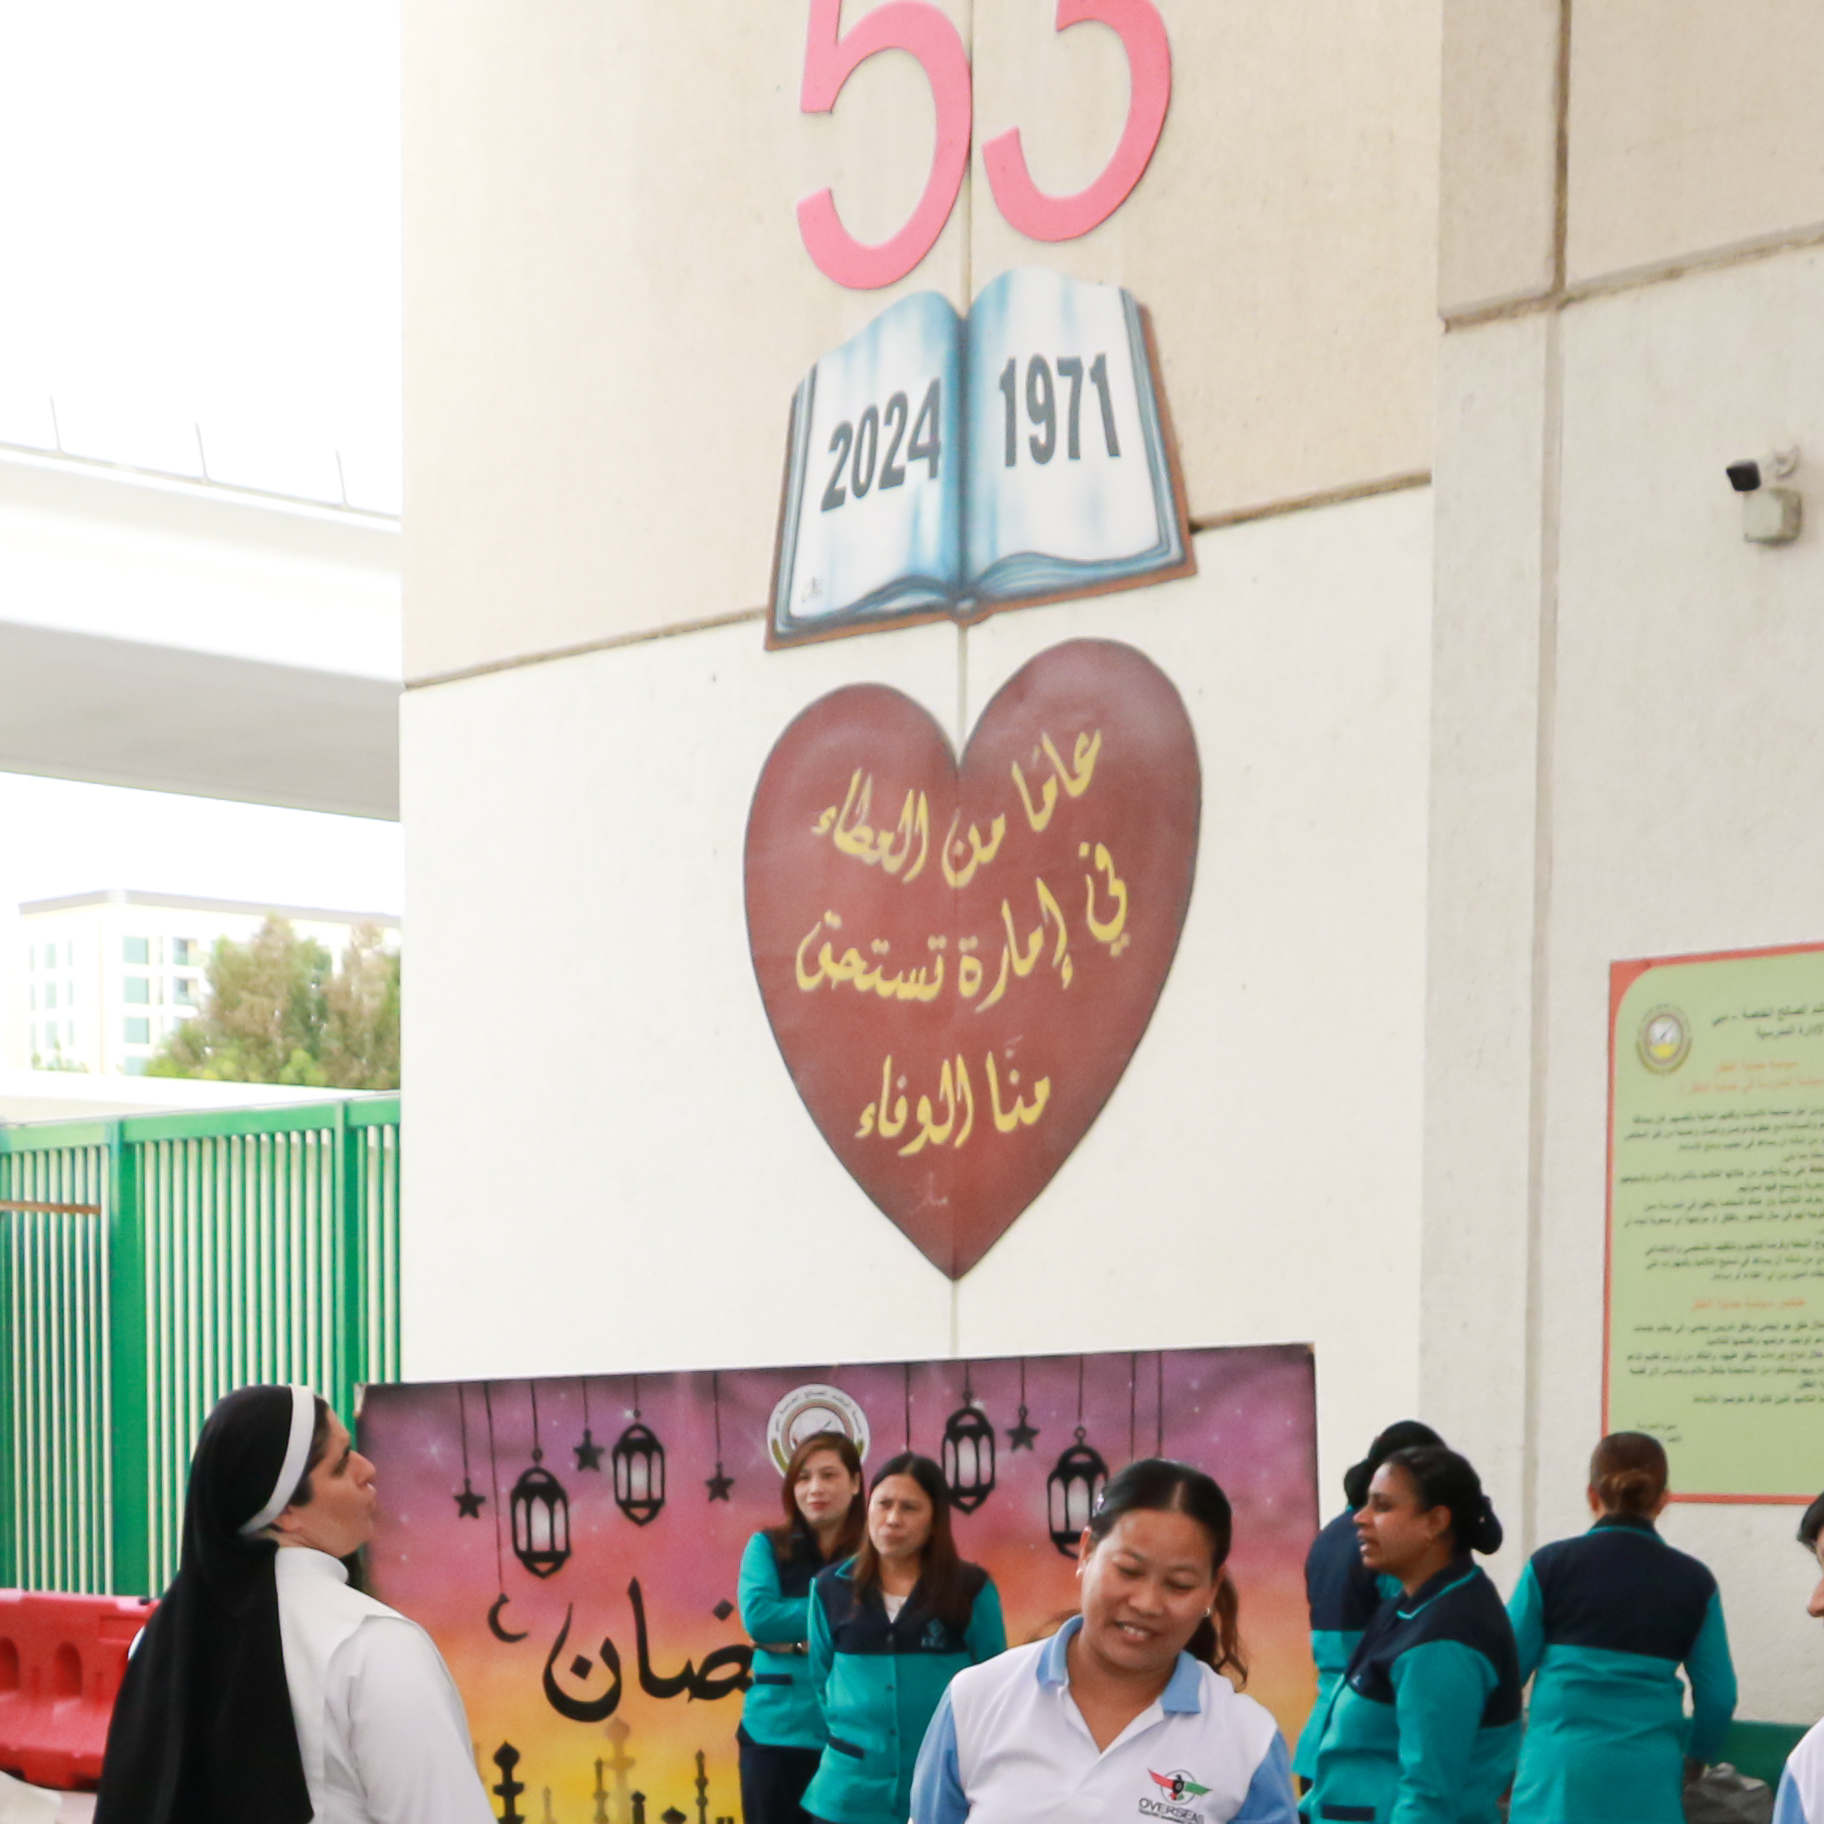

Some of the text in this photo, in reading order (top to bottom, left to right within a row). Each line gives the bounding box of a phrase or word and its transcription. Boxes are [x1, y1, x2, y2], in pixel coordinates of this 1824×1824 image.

[821, 378, 942, 511] 2024
[999, 353, 1121, 467] 1971
[811, 768, 930, 883] العطاء
[941, 806, 1007, 888] من
[795, 909, 948, 1002] تستحق
[1078, 841, 1131, 957] في
[855, 1055, 973, 1157] الوفاء
